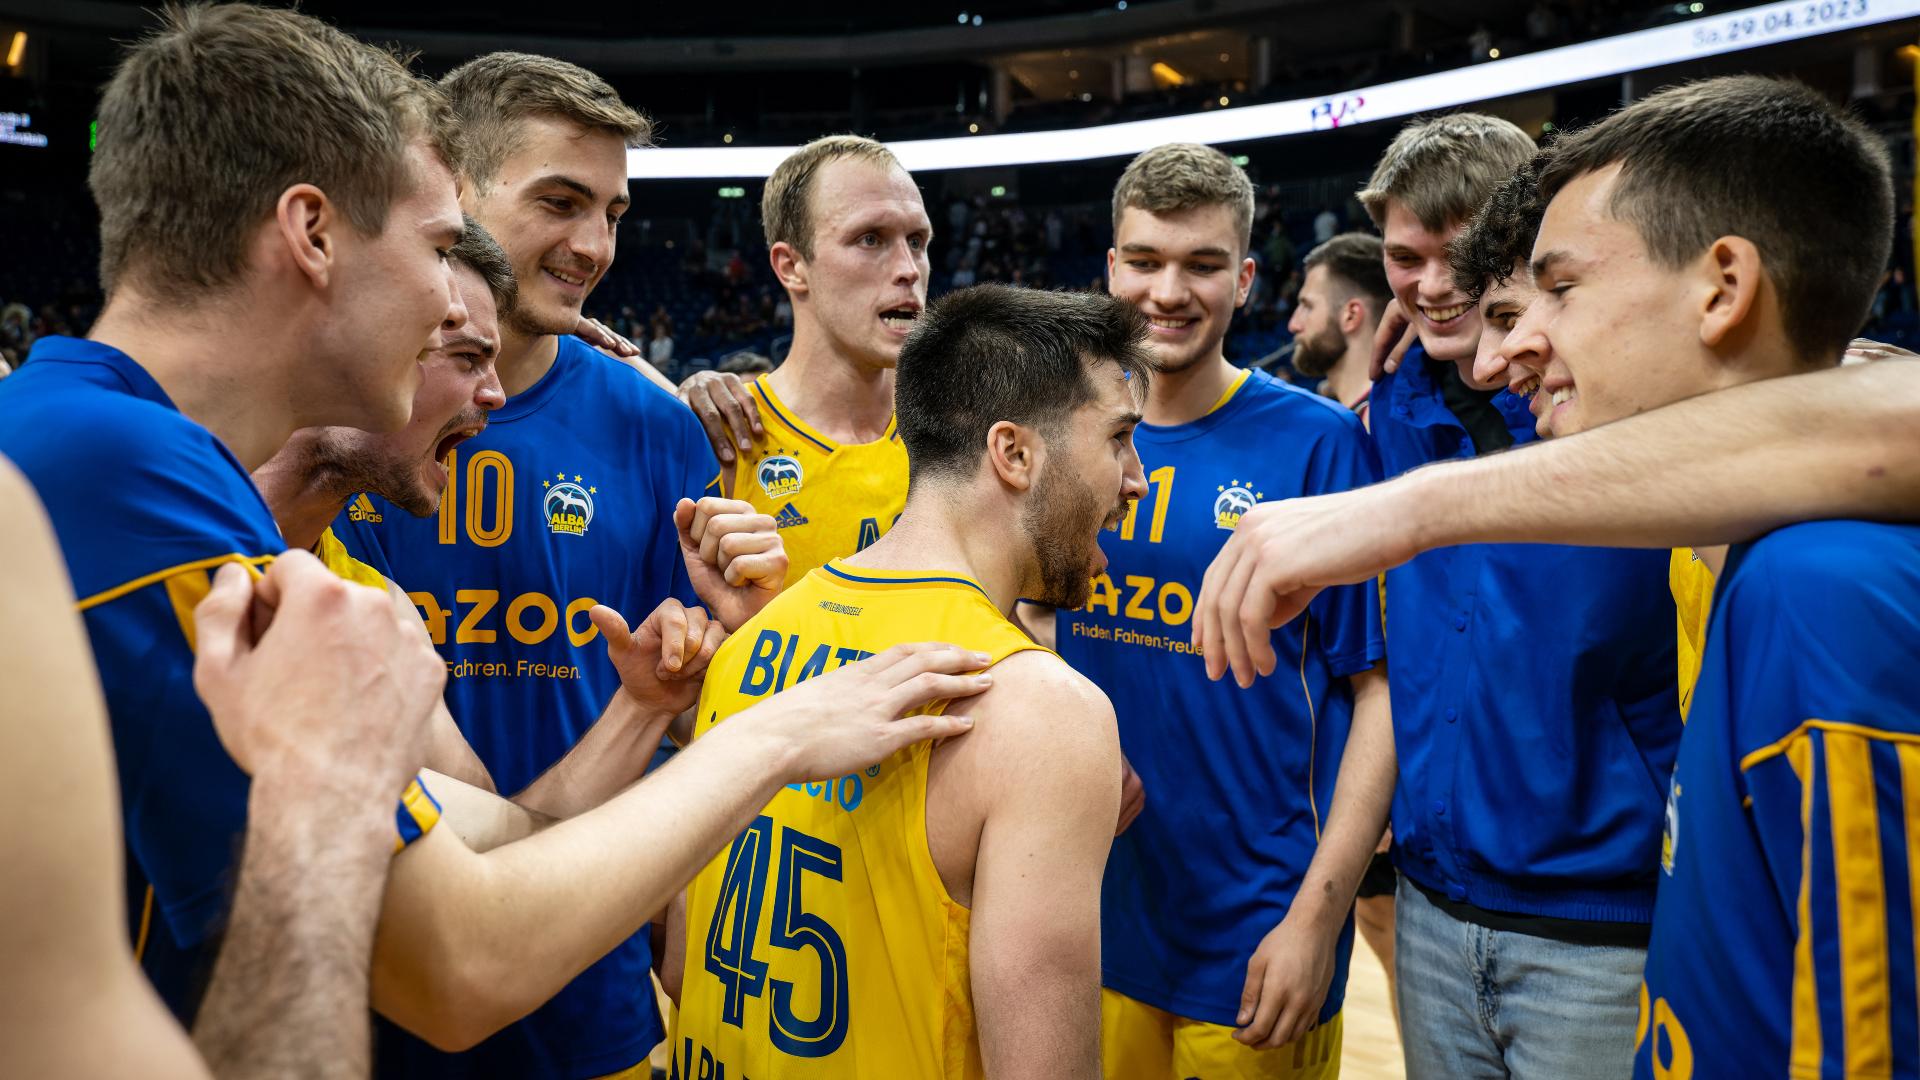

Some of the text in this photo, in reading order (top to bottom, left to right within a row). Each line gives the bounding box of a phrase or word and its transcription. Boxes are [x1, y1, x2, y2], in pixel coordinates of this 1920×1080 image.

[767, 477, 799, 492] ALBA
[439, 449, 514, 547] 10
[551, 513, 585, 528] ALBA
[553, 524, 582, 534] BERLIN
[517, 660, 581, 679] Freuen.
[705, 815, 849, 1058] 45
